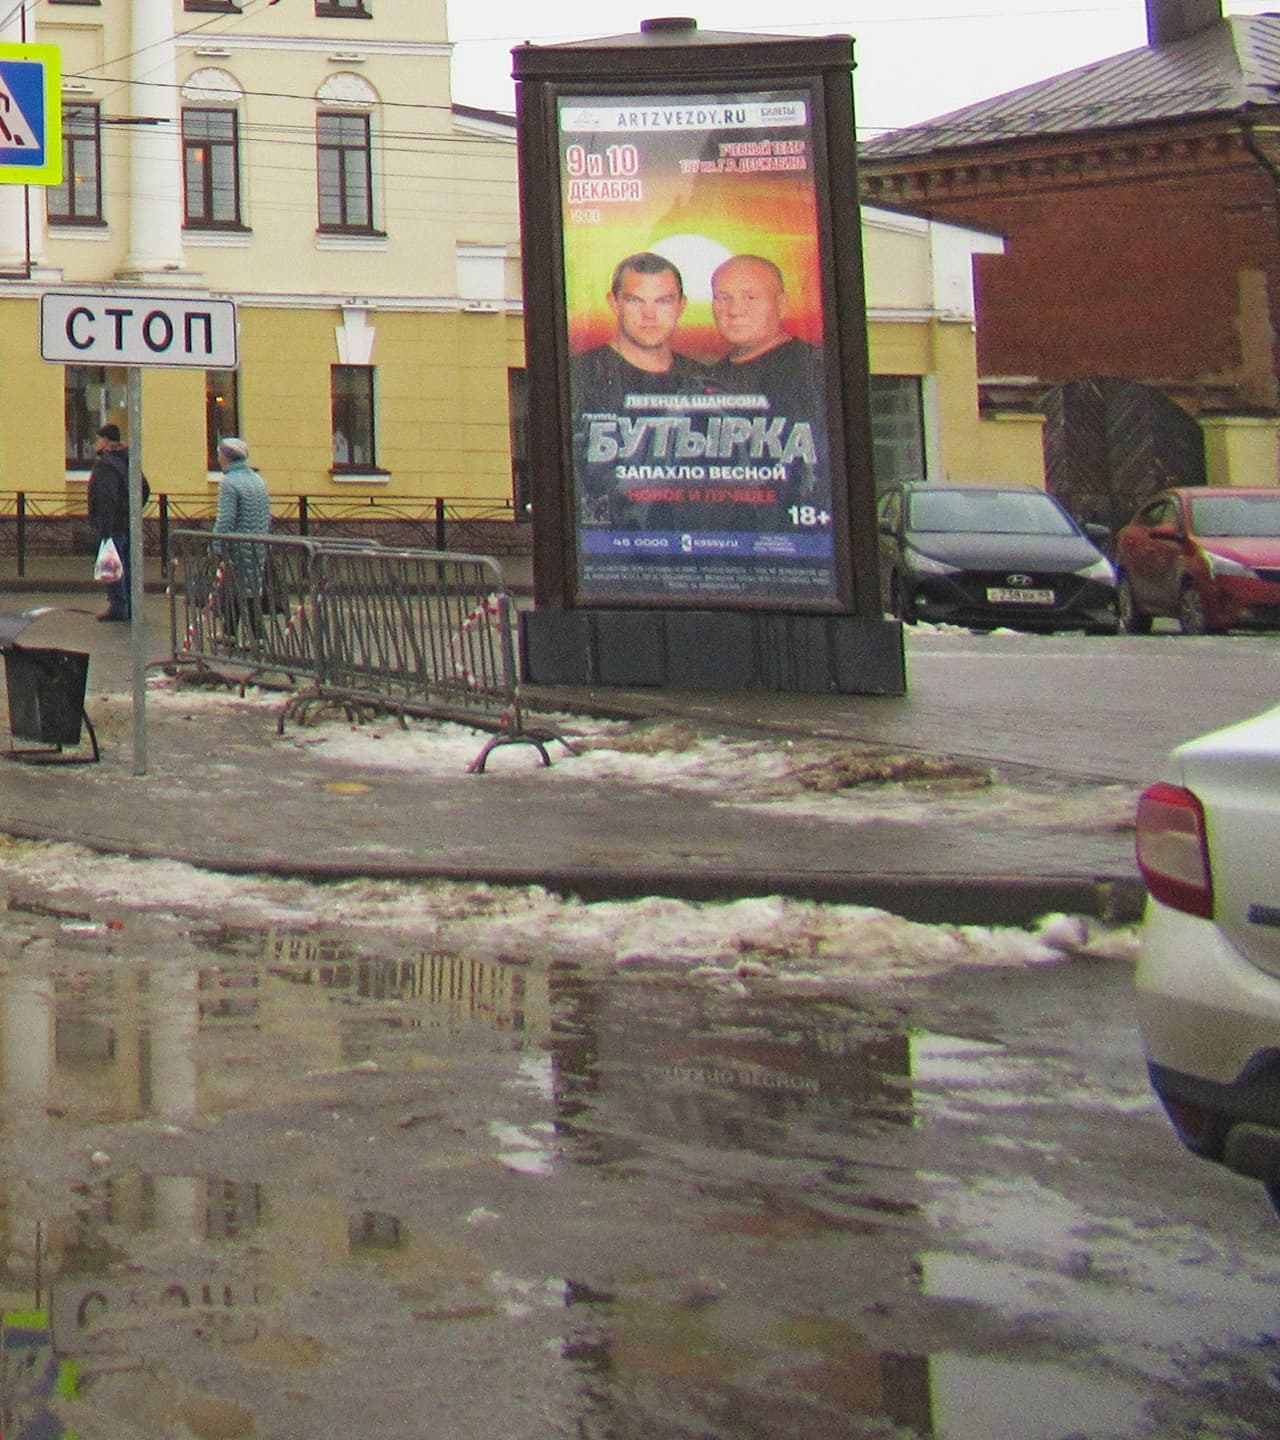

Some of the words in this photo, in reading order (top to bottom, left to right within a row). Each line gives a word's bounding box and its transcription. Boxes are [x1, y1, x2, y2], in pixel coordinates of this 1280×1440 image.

[617, 109, 747, 128] ARTZVEZDY.RU
[567, 145, 585, 175] 9
[606, 144, 638, 175] 10
[569, 180, 642, 202] ДЕКАБРЯ
[65, 307, 213, 354] СТОП
[587, 417, 817, 464] БУТЫРКА
[615, 465, 705, 480] ЗАПАХЛО
[709, 463, 787, 480] ВЕСНОЙ
[788, 505, 831, 526] 18+
